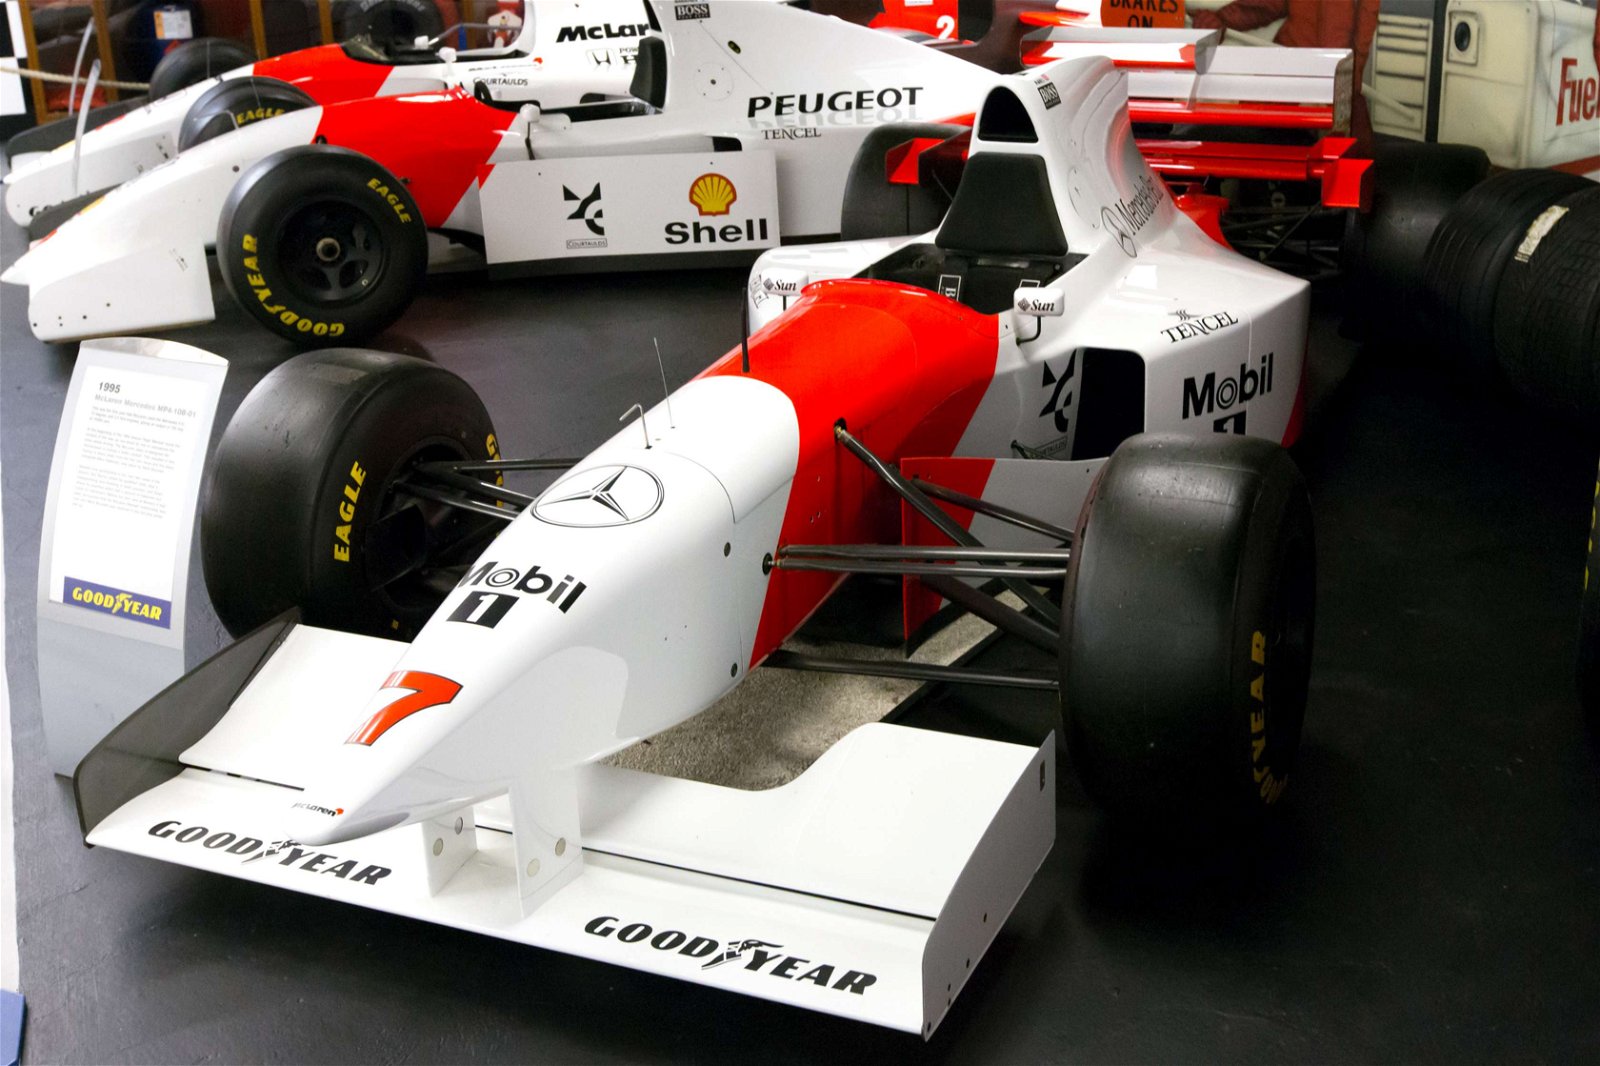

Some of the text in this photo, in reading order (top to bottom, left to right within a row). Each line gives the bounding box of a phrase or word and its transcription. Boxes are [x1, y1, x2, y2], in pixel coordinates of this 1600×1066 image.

[936, 15, 955, 40] 2
[236, 108, 285, 125] EAGLE
[747, 87, 924, 118] PEUGEOT
[761, 127, 822, 141] TENCEL
[367, 178, 412, 224] EAGLE
[664, 218, 768, 245] Shell
[774, 279, 797, 291] Sun
[1030, 299, 1055, 312] Sun
[1160, 311, 1239, 343] TENCEL
[99, 381, 121, 394] 1995
[1182, 352, 1274, 420] Mobil
[334, 461, 367, 562] EAGLE
[458, 561, 587, 614] Mobil
[342, 670, 464, 747] 7
